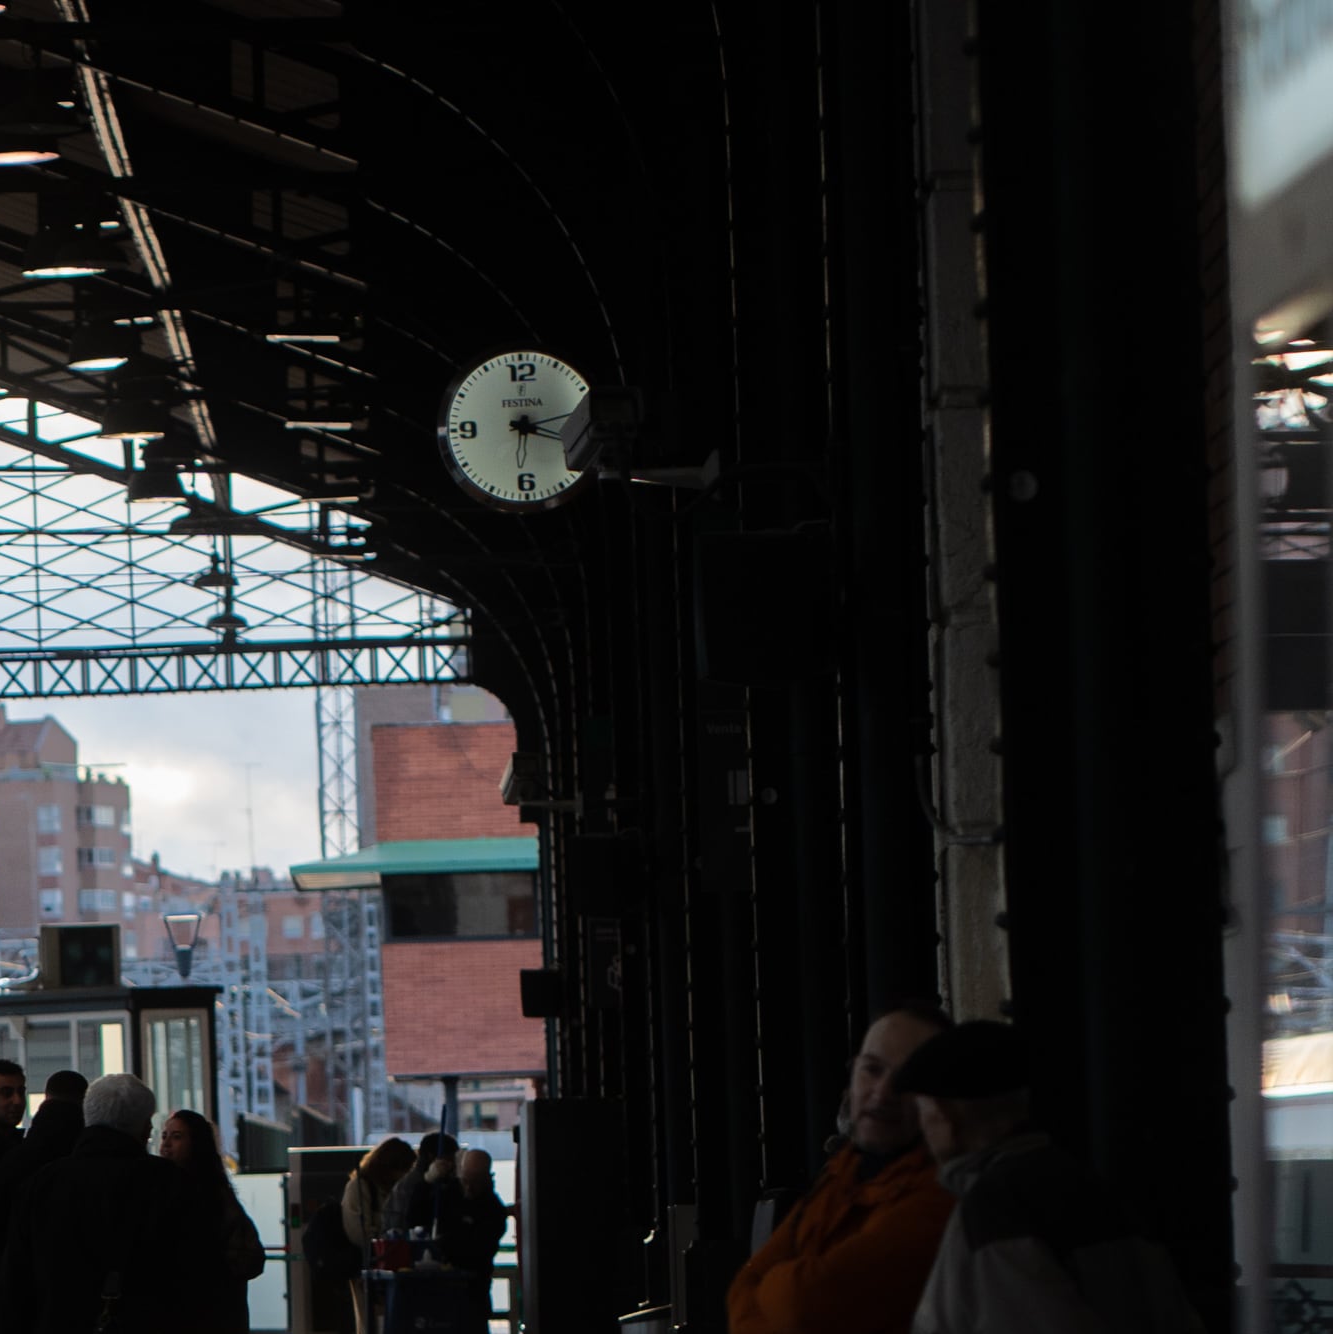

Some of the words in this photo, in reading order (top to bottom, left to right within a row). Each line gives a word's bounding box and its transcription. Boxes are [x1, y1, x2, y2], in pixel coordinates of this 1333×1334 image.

[505, 362, 537, 382] 12
[501, 398, 543, 408] FESTINA
[459, 421, 478, 439] 9
[518, 473, 535, 491] 6
